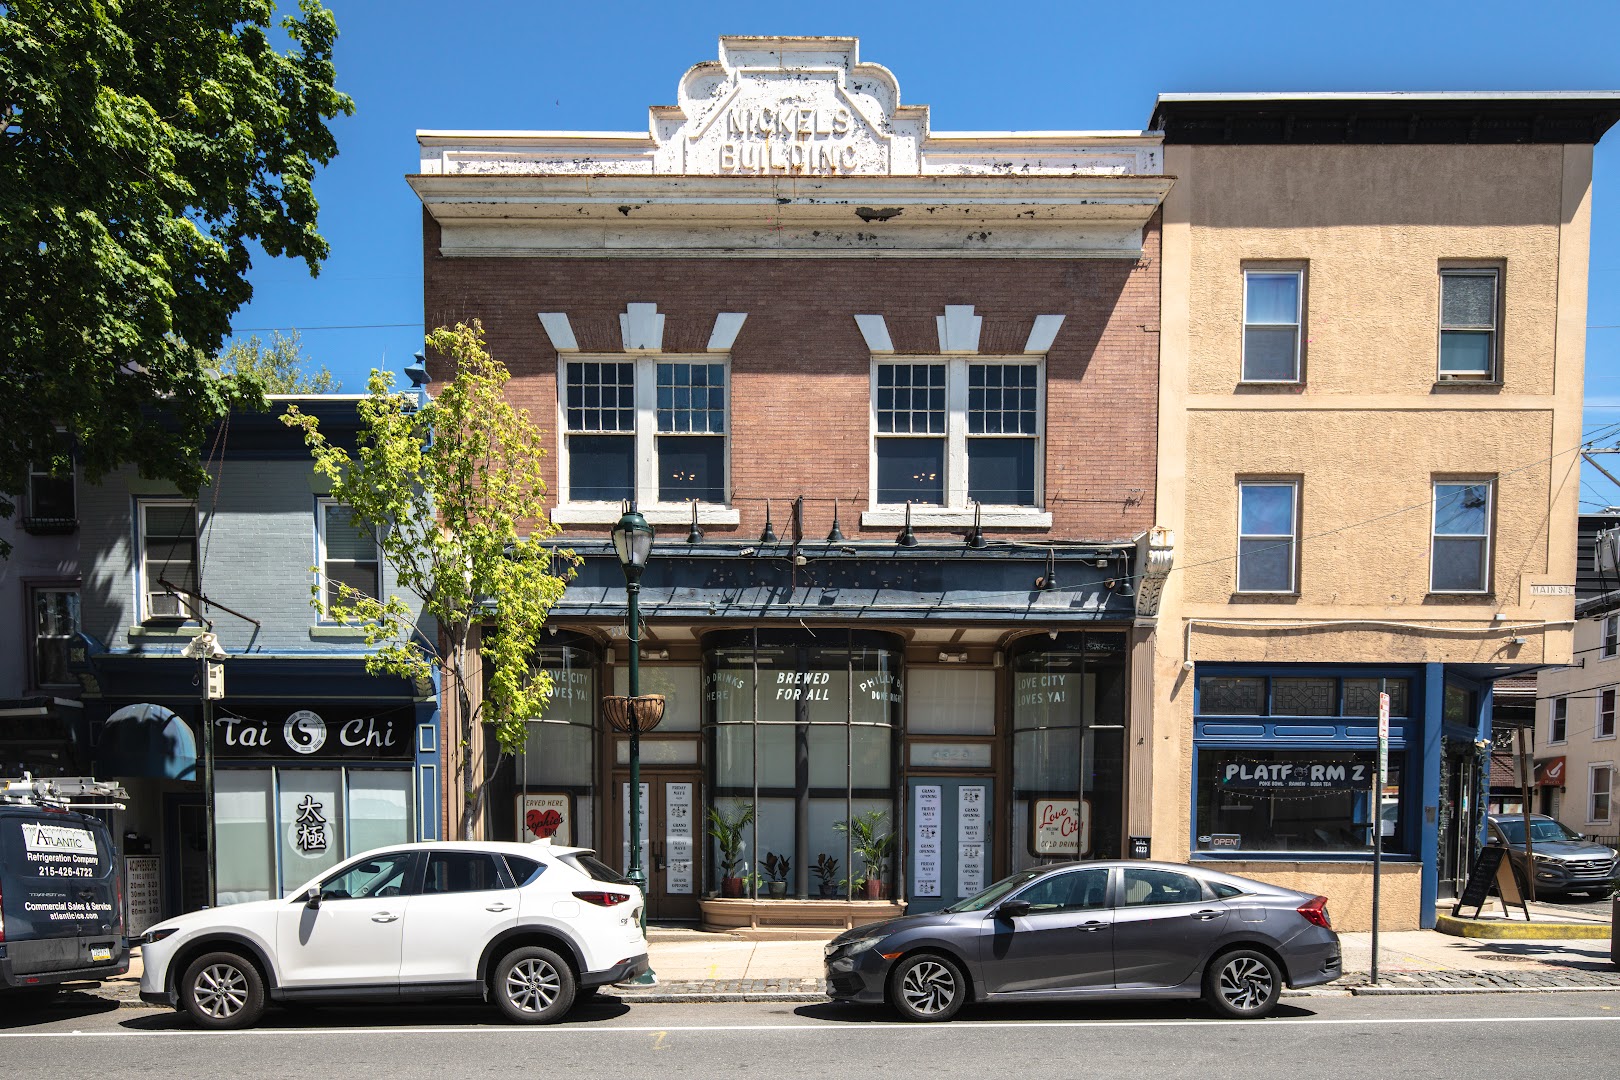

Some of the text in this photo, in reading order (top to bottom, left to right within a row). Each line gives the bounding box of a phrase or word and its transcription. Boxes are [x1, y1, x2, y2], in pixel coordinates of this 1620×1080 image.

[728, 108, 851, 136] NICKELS
[720, 144, 858, 172] BUILDING
[1532, 586, 1556, 594] MAIN
[546, 670, 588, 685] OVE CITY
[712, 672, 745, 689] DRINKS
[776, 672, 830, 685] BREWED
[859, 674, 895, 692] PHILLY
[1018, 675, 1066, 690] LOVE CITY
[541, 685, 588, 701] OVES YA!
[706, 690, 729, 702] HERE
[776, 688, 830, 701] FOR ALL
[871, 690, 888, 701] DONE
[1018, 691, 1065, 707] LOVES YA!
[214, 717, 396, 747] Tai Chi
[526, 799, 564, 807] ERVED HERE
[297, 794, 327, 851] 太極
[522, 811, 564, 836] Sophie's
[1039, 804, 1069, 829] Love
[36, 827, 83, 848] ATLANTIC
[544, 828, 557, 838] BBQ
[1040, 840, 1057, 848] COLD
[1213, 838, 1237, 846] OPEN
[27, 852, 99, 866] Refrigeration Company
[38, 866, 93, 877] 215-426-4722
[24, 900, 112, 911] Commercial Sales & Service
